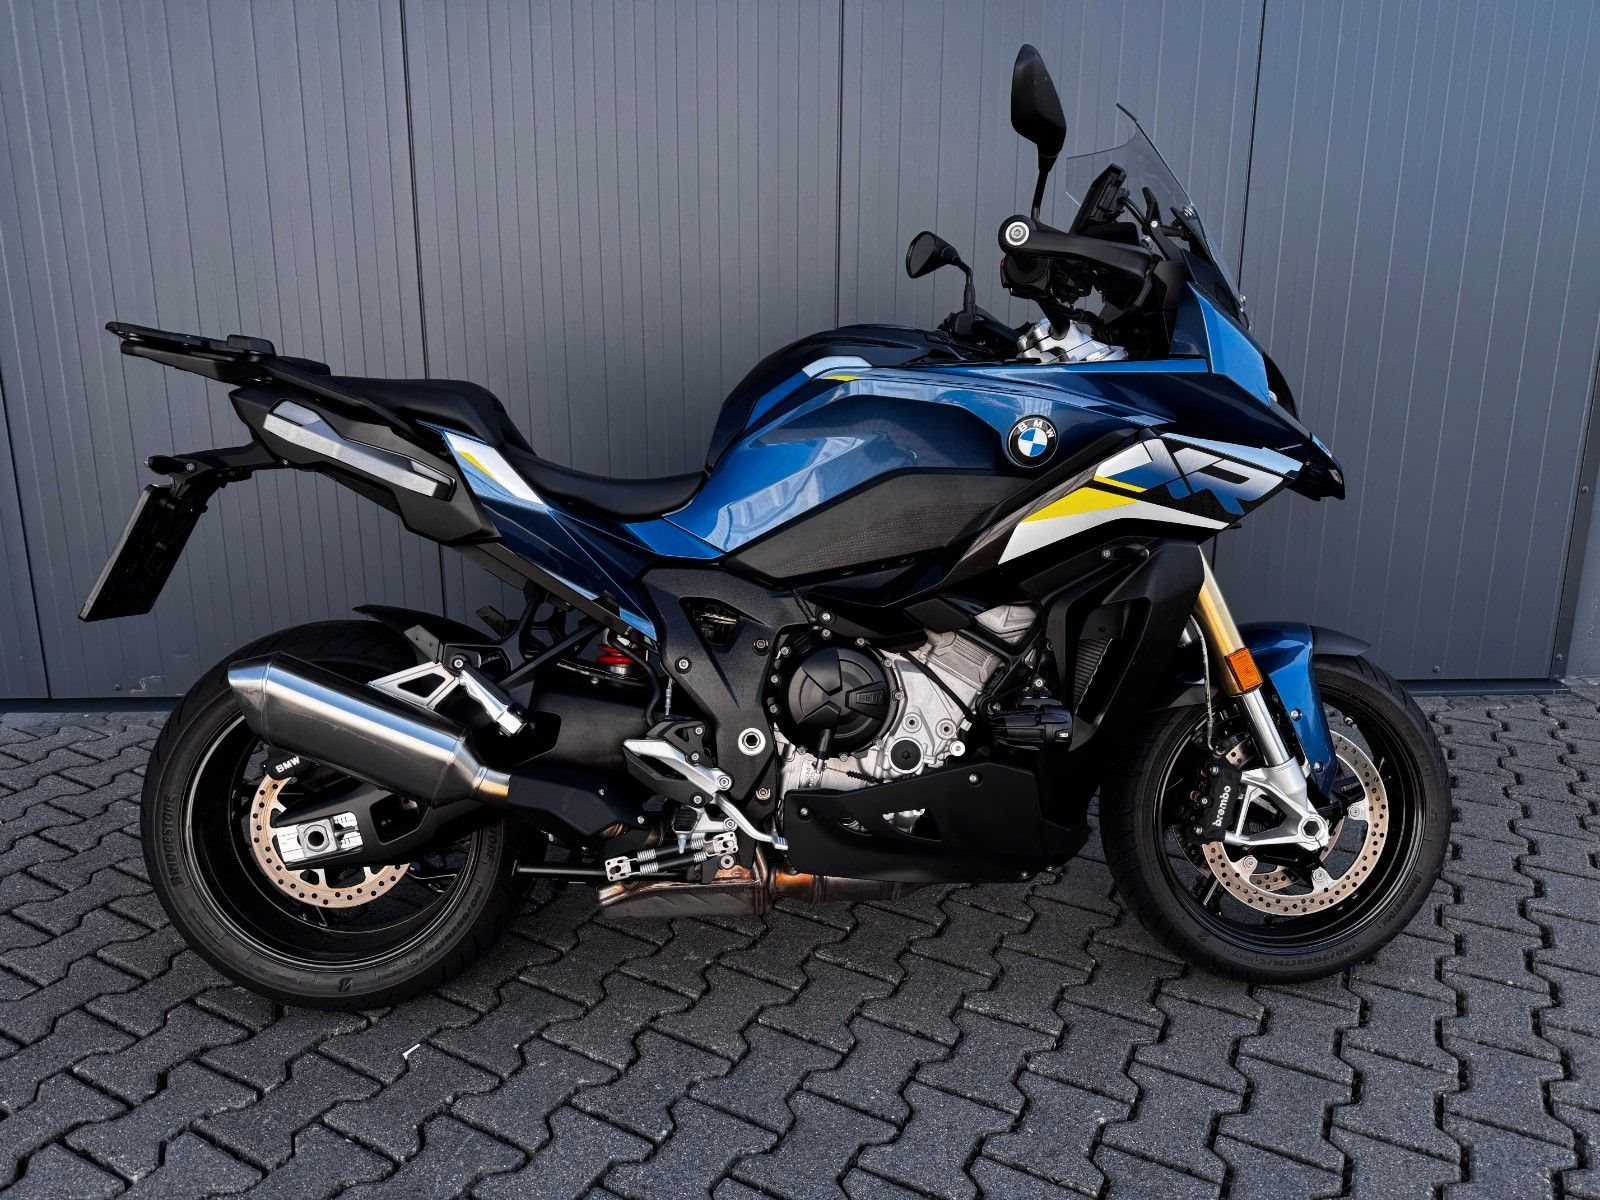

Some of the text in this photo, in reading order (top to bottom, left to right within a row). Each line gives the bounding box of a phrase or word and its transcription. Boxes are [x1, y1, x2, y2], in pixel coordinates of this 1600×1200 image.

[1018, 419, 1056, 438] BMW
[275, 755, 300, 773] BMW
[1211, 785, 1231, 827] brembo
